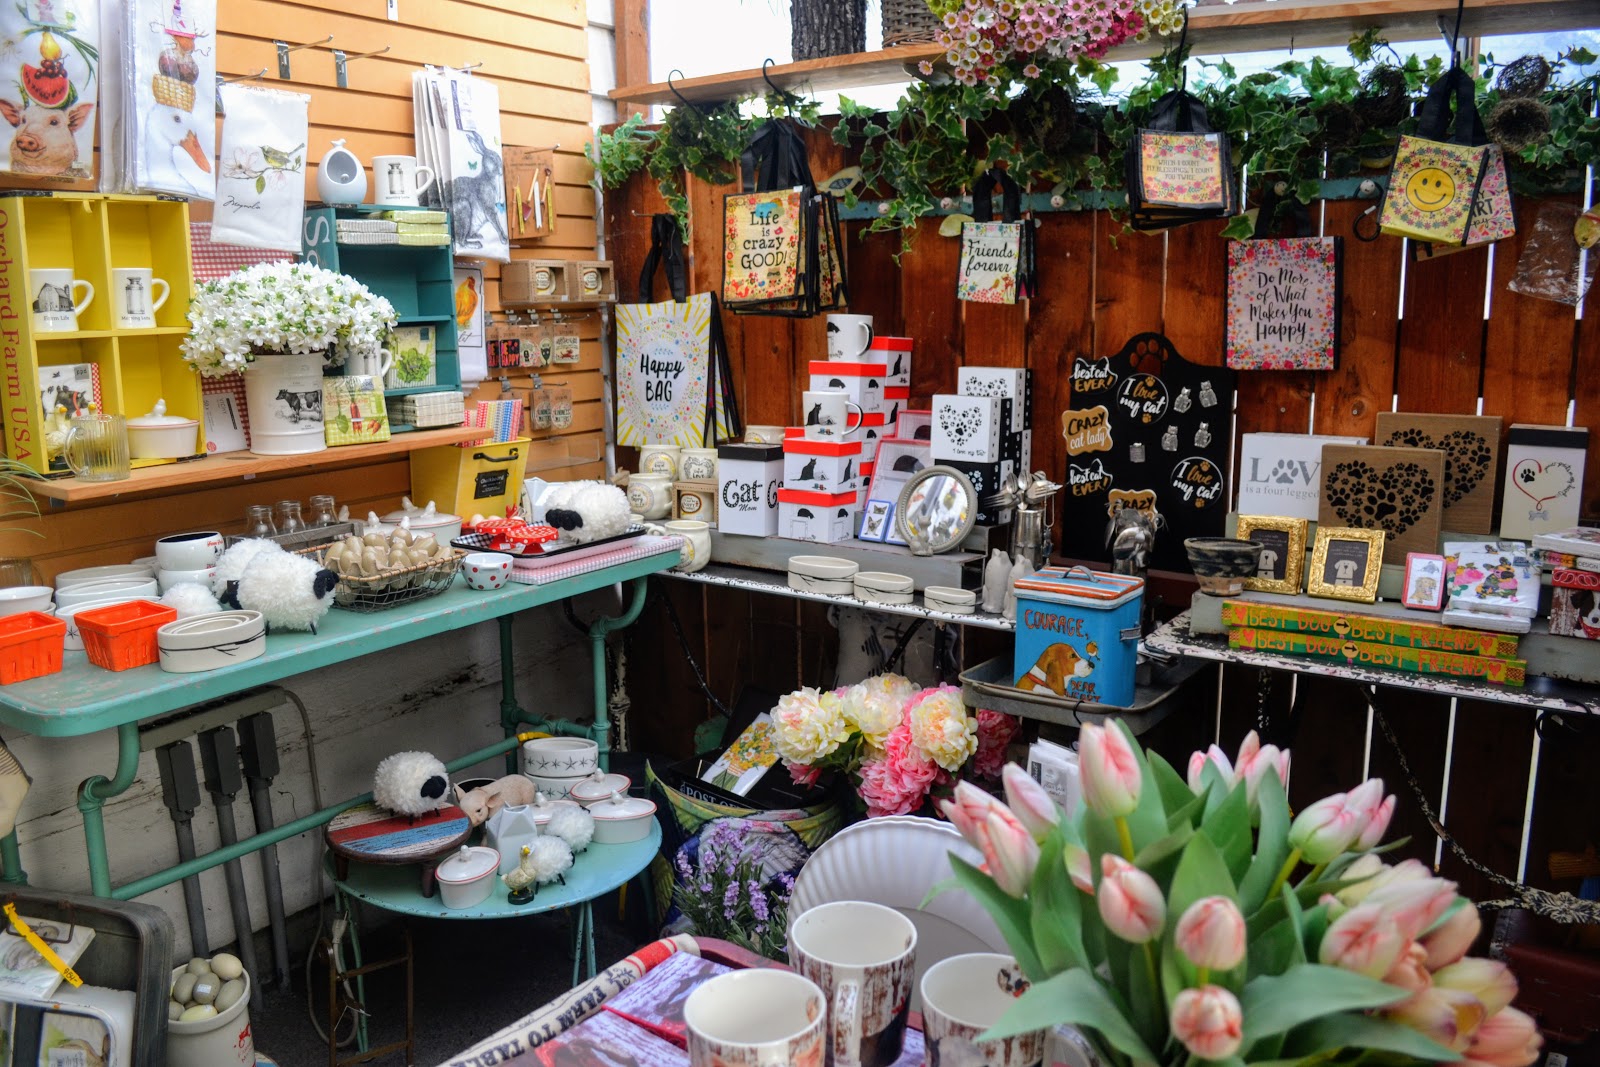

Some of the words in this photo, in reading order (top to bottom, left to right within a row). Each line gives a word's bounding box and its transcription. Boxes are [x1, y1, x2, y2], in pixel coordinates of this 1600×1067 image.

[750, 211, 780, 226] Life
[762, 228, 770, 236] is
[743, 236, 784, 250] crazy
[968, 239, 1014, 258] Friends
[0, 209, 18, 320] Orchard
[741, 250, 788, 270] GOOD!
[966, 255, 1012, 276] forever
[1257, 272, 1275, 288] Do
[1279, 268, 1309, 286] More
[1256, 288, 1270, 304] of
[1274, 284, 1306, 302] What
[1250, 302, 1287, 322] Makes
[1289, 302, 1312, 323] You
[1256, 322, 1306, 344] Happy
[2, 328, 20, 398] Farm
[640, 354, 685, 380] Happy
[1074, 364, 1096, 379] best
[1094, 364, 1109, 378] cat
[646, 380, 672, 402] BAG
[1074, 376, 1114, 392] EVER!
[1123, 378, 1136, 396] I
[1133, 381, 1158, 400] love
[1120, 396, 1140, 418] my
[1143, 396, 1166, 414] cat
[10, 406, 32, 460] USA
[1068, 412, 1106, 436] CRAZY
[1070, 432, 1086, 450] cat
[1087, 427, 1109, 447] lady
[1070, 468, 1090, 485] best
[1090, 468, 1102, 480] cat
[1178, 462, 1190, 478] I
[1186, 465, 1213, 484] love
[723, 479, 763, 508] Cat
[1072, 477, 1108, 496] EVER!
[1172, 479, 1194, 501] my
[1196, 482, 1220, 500] cat
[1246, 484, 1254, 494] is
[1264, 486, 1284, 495] four
[738, 504, 757, 512] Mom
[1578, 561, 1598, 569] DESIGN
[1024, 609, 1089, 640] COURAGE,
[1249, 606, 1288, 629] BEST
[1298, 613, 1332, 632] DOG
[1351, 616, 1400, 644] BEST
[1410, 626, 1480, 651] FRIEND
[1258, 630, 1297, 652] BEST
[1306, 635, 1340, 656] DOG
[1360, 642, 1408, 668] BEST
[1418, 650, 1488, 676] FRIEND
[1070, 680, 1096, 694] DEAR
[686, 784, 716, 802] POST
[559, 985, 607, 1032] FARM
[528, 1022, 557, 1048] TO
